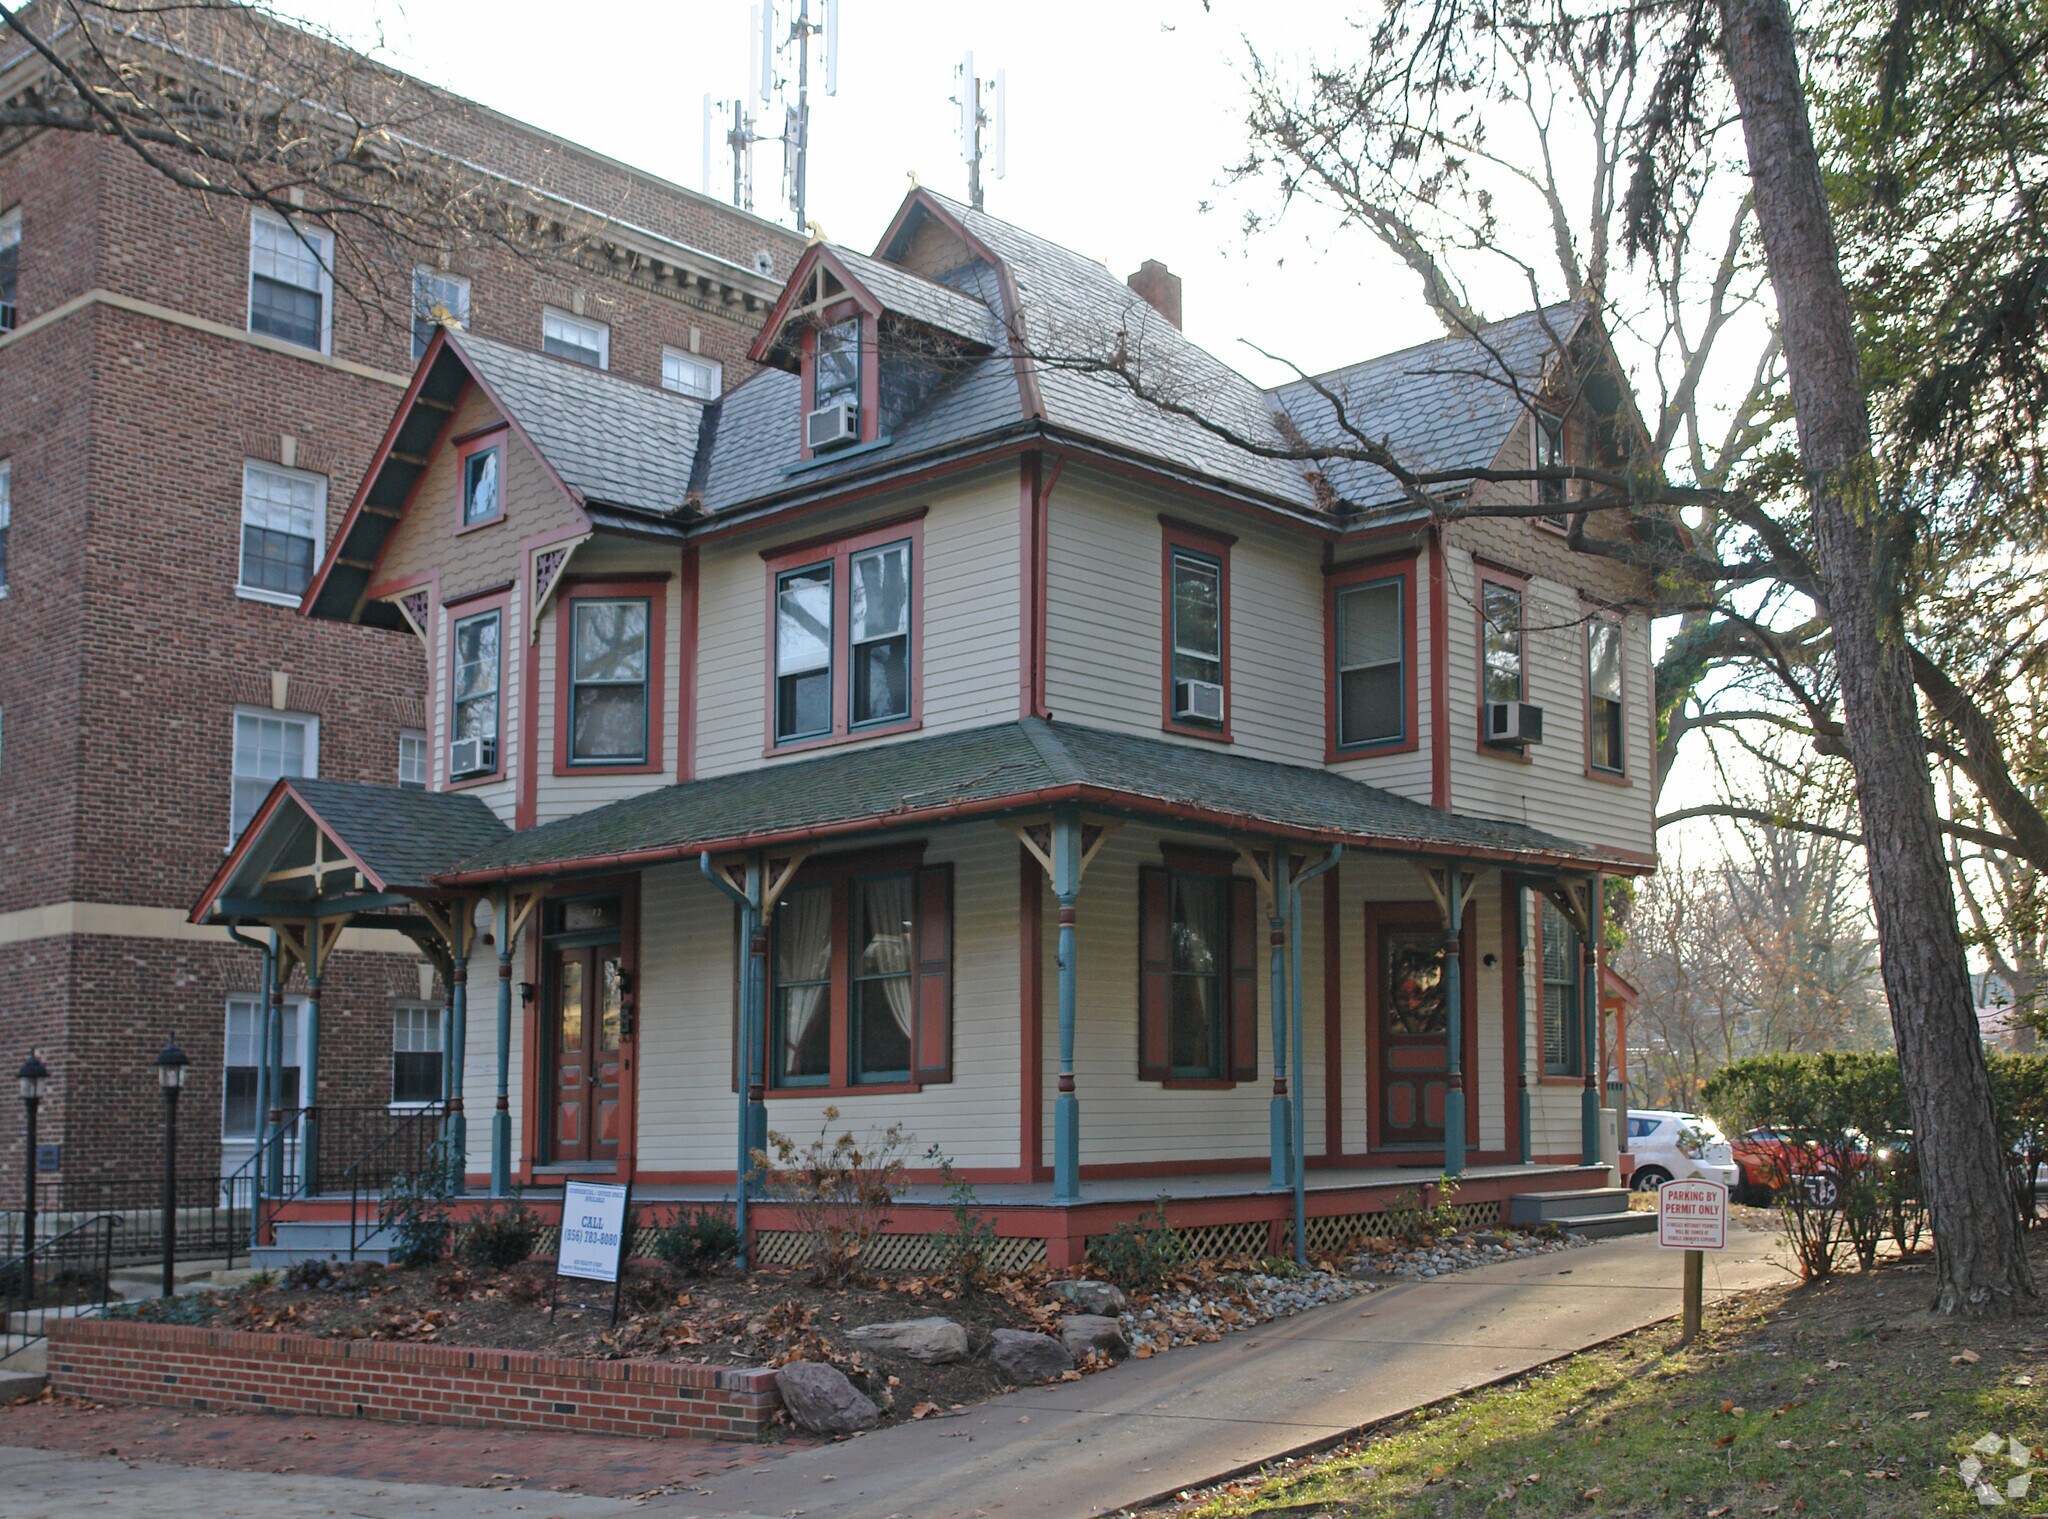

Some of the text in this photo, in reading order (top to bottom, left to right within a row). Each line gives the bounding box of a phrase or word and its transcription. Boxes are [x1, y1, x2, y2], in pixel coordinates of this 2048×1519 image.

[1668, 1190, 1717, 1202] PARKING BY
[1665, 1204, 1720, 1215] PERMIT ONLY
[581, 1216, 604, 1230] CALL
[564, 1229, 618, 1247] (856) 783-8080
